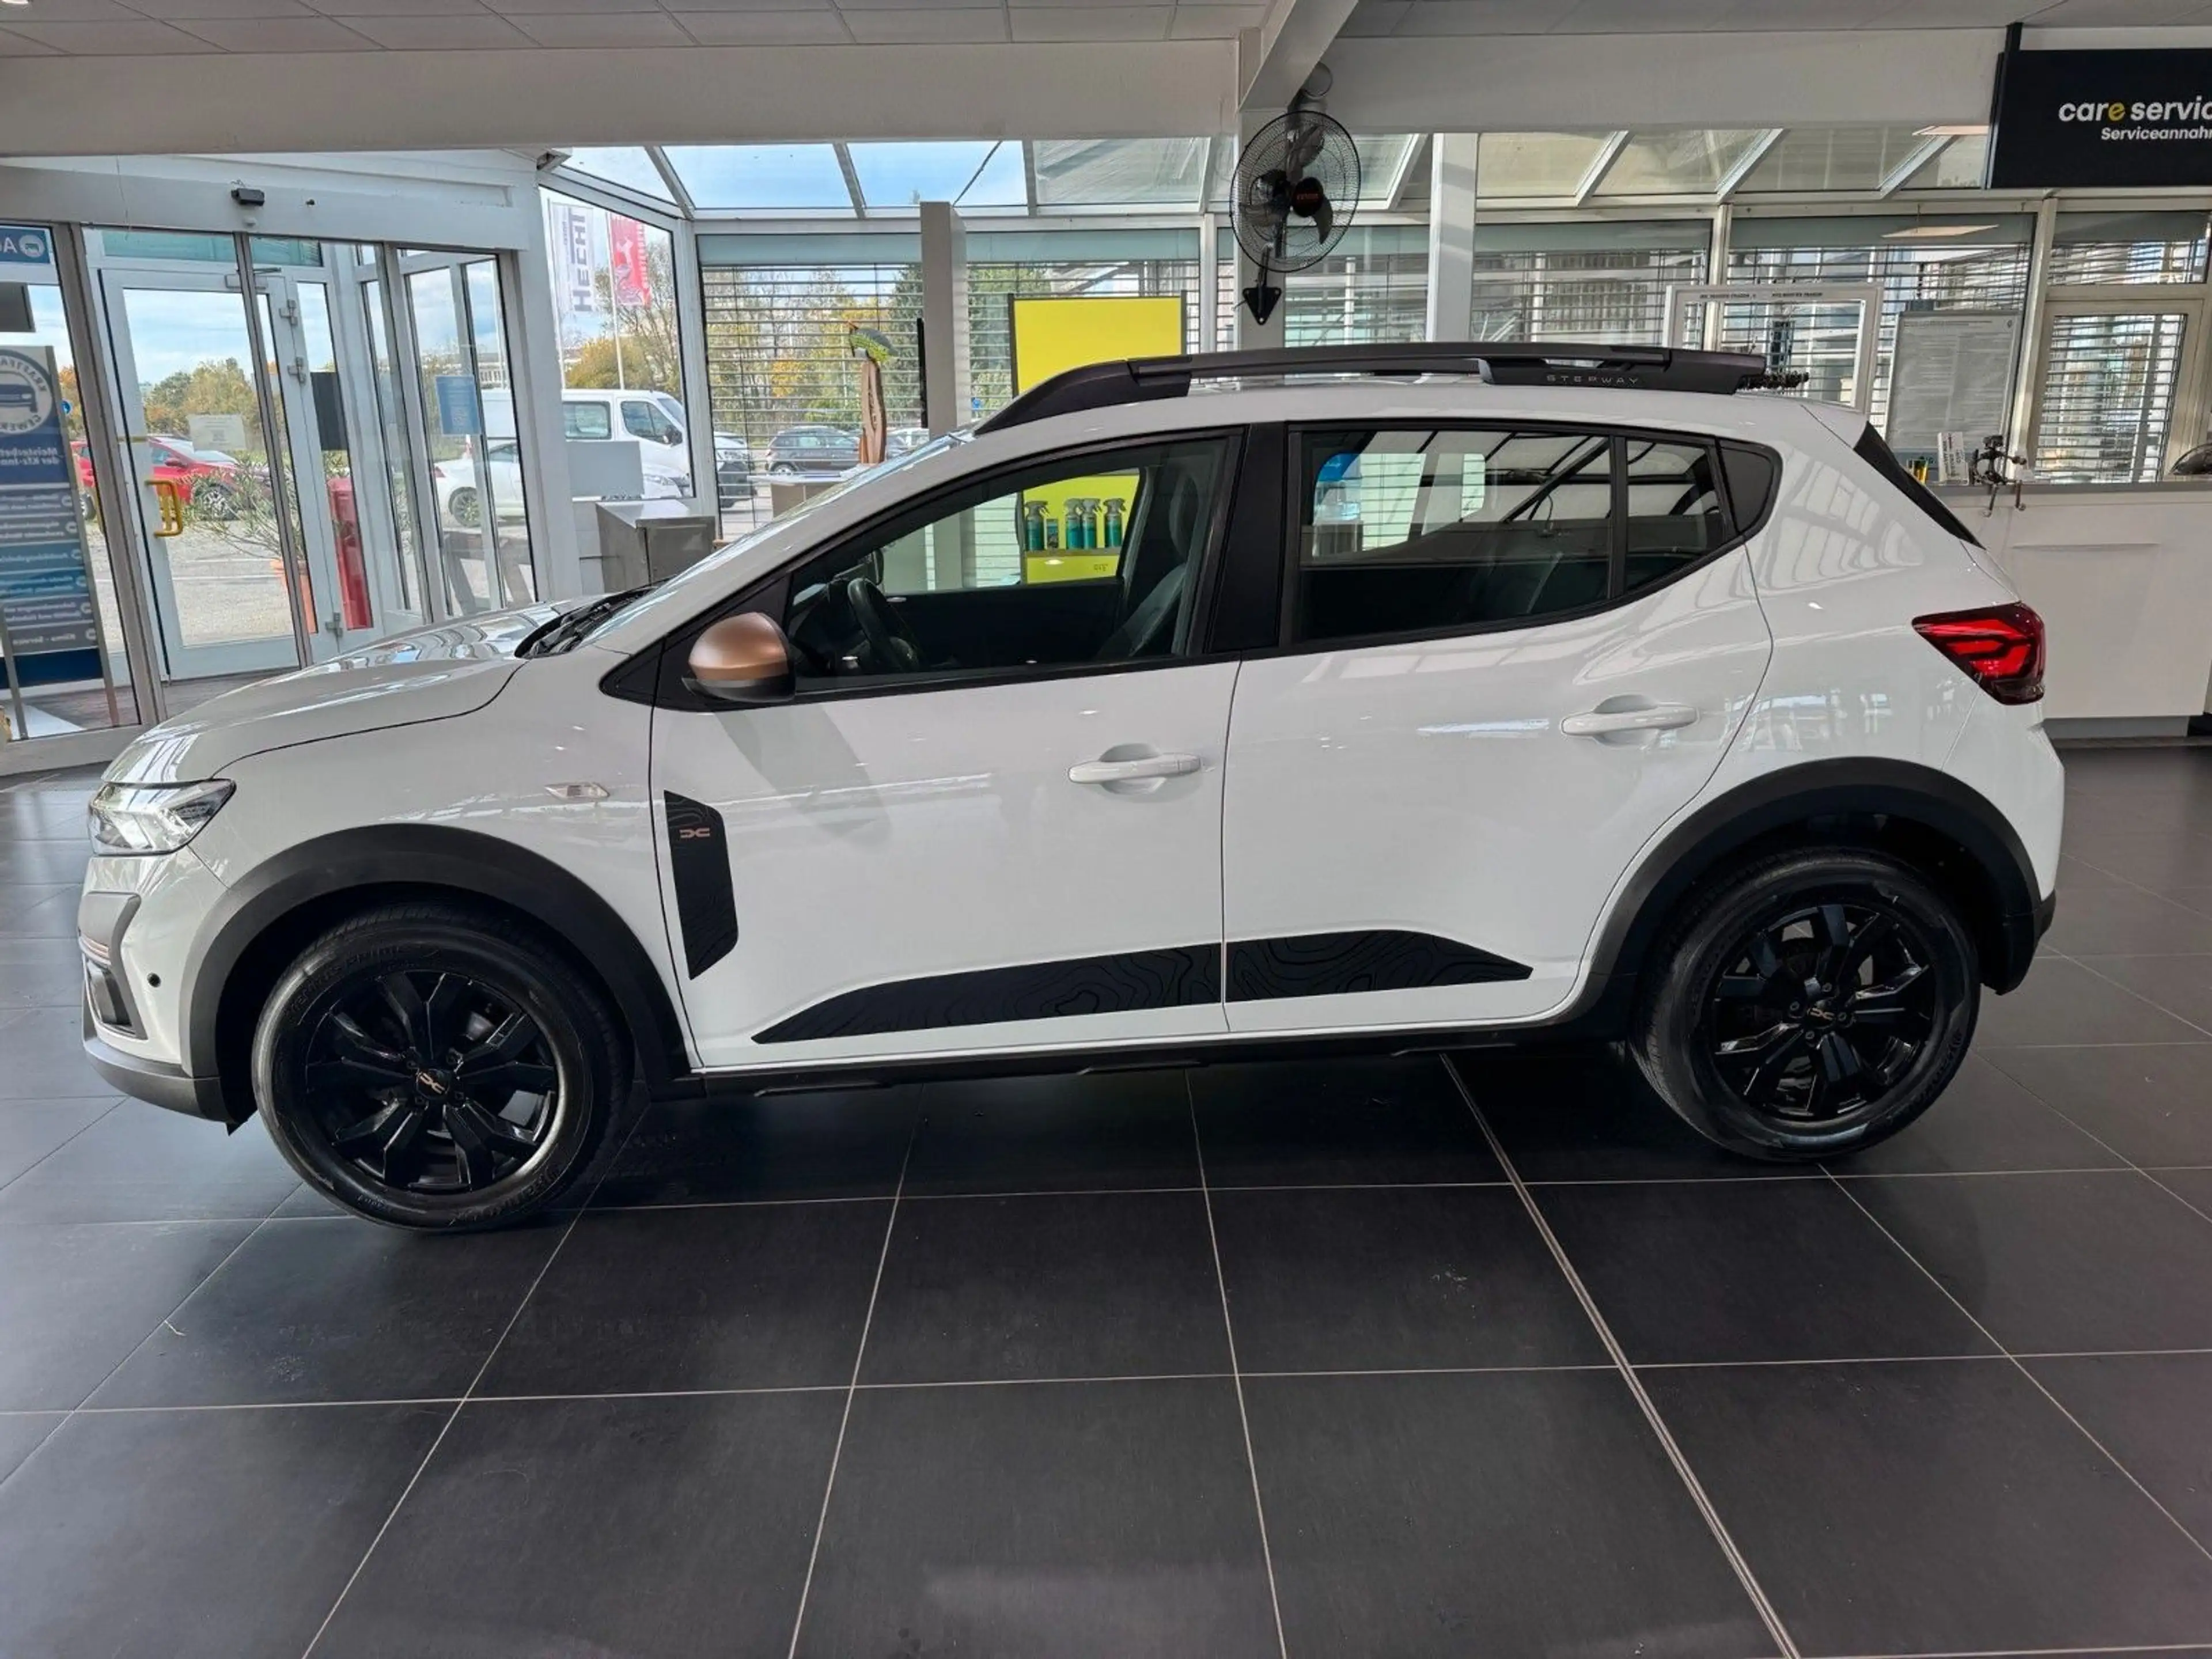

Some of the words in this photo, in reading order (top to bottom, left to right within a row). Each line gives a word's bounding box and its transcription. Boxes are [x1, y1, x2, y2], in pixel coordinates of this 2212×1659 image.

[2058, 101, 2126, 122] care
[568, 207, 592, 313] HECHT
[1546, 374, 1639, 385] STEPWAY
